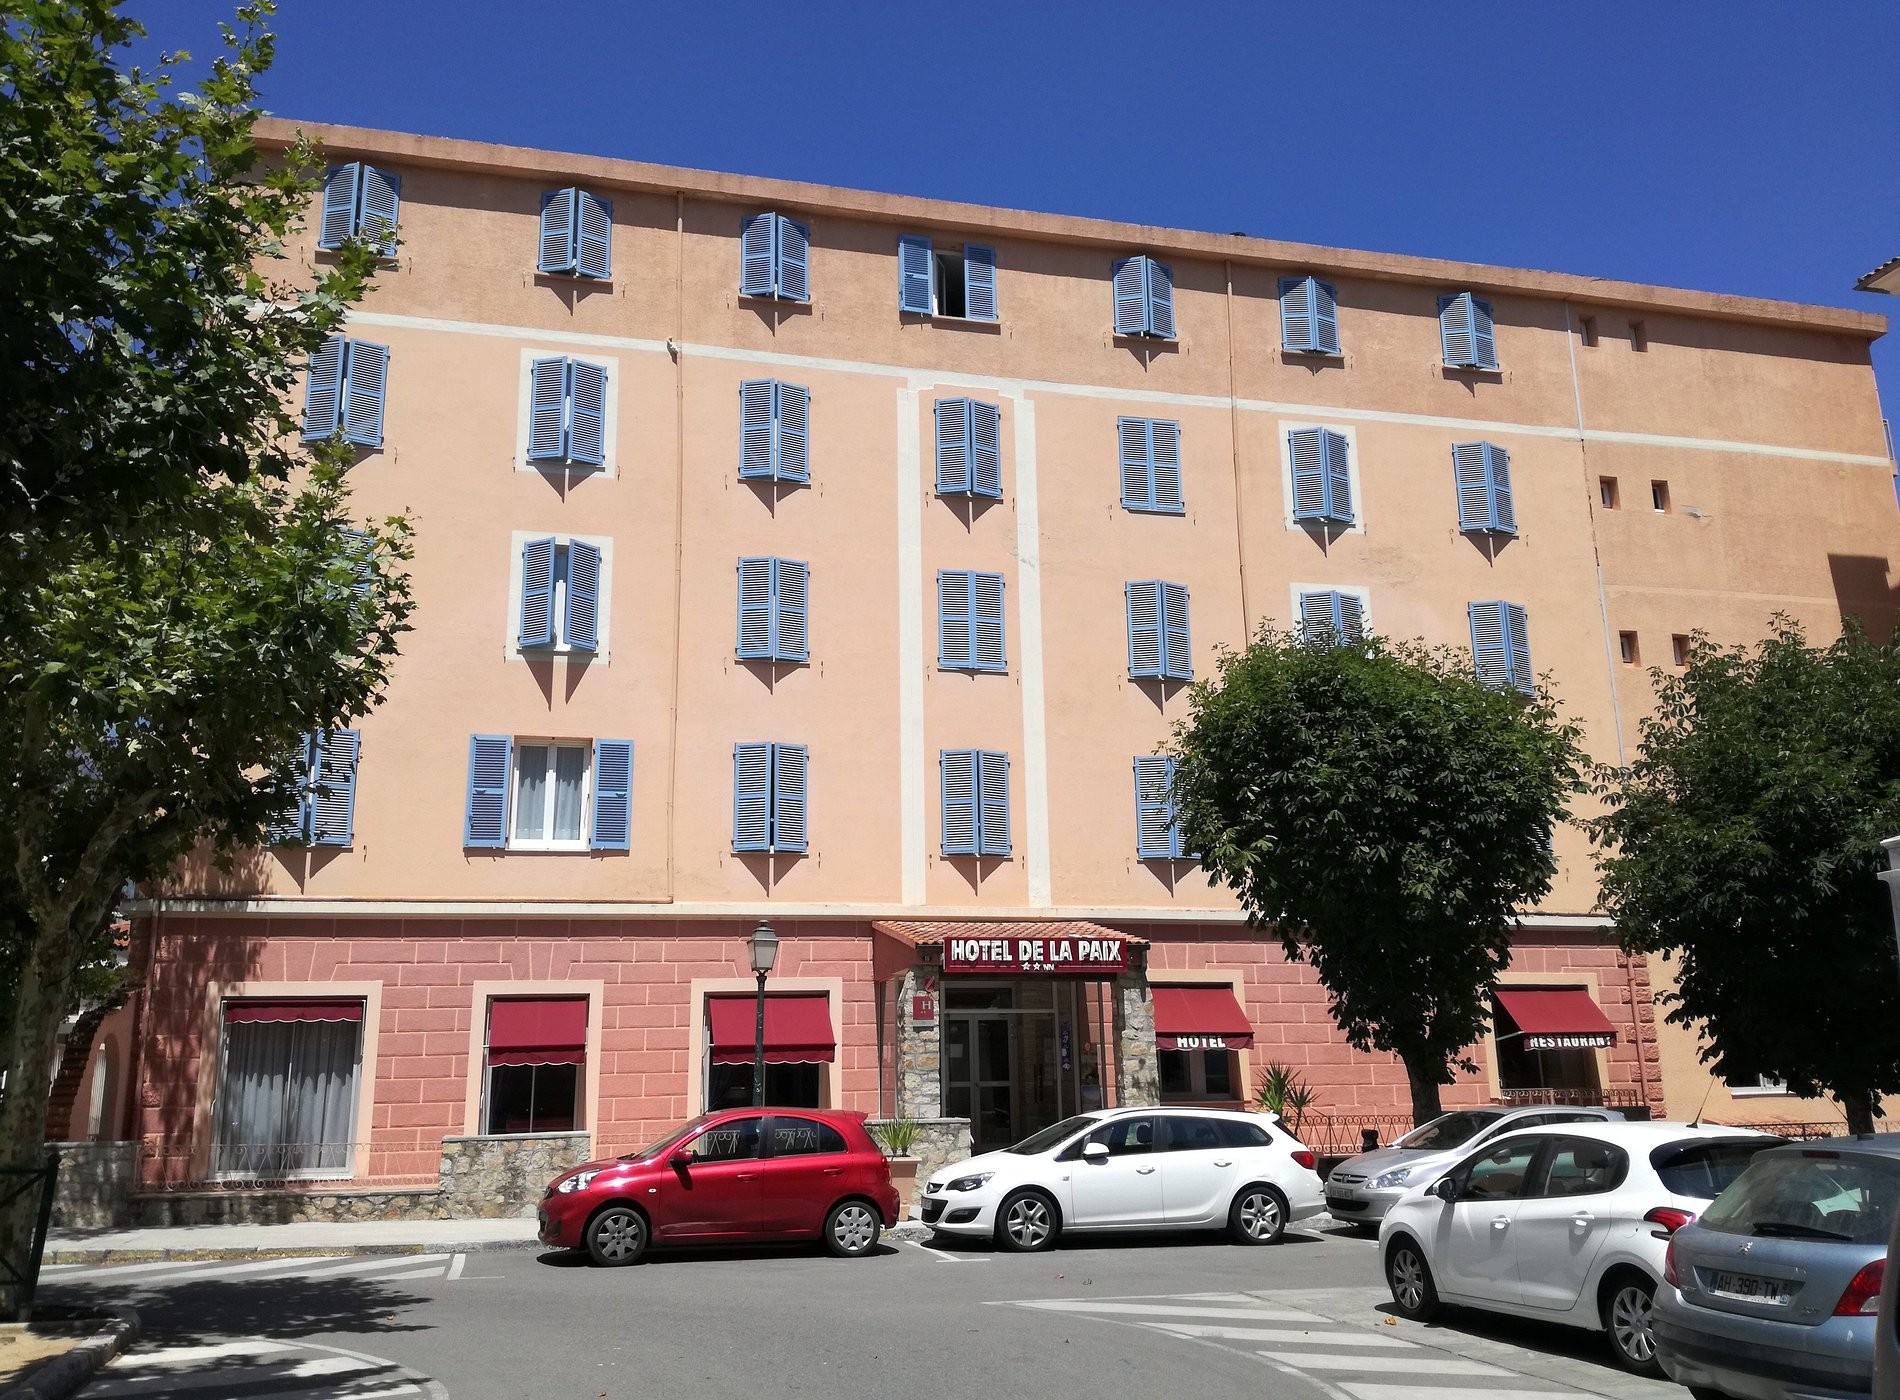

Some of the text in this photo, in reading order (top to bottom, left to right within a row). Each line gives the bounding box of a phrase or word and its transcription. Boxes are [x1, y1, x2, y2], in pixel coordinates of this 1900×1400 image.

[951, 939, 1122, 961] HOTEL DE LA PAIX
[922, 1000, 931, 1010] H
[1176, 1035, 1226, 1048] HOTEL
[1529, 1034, 1611, 1048] RESTAURANT
